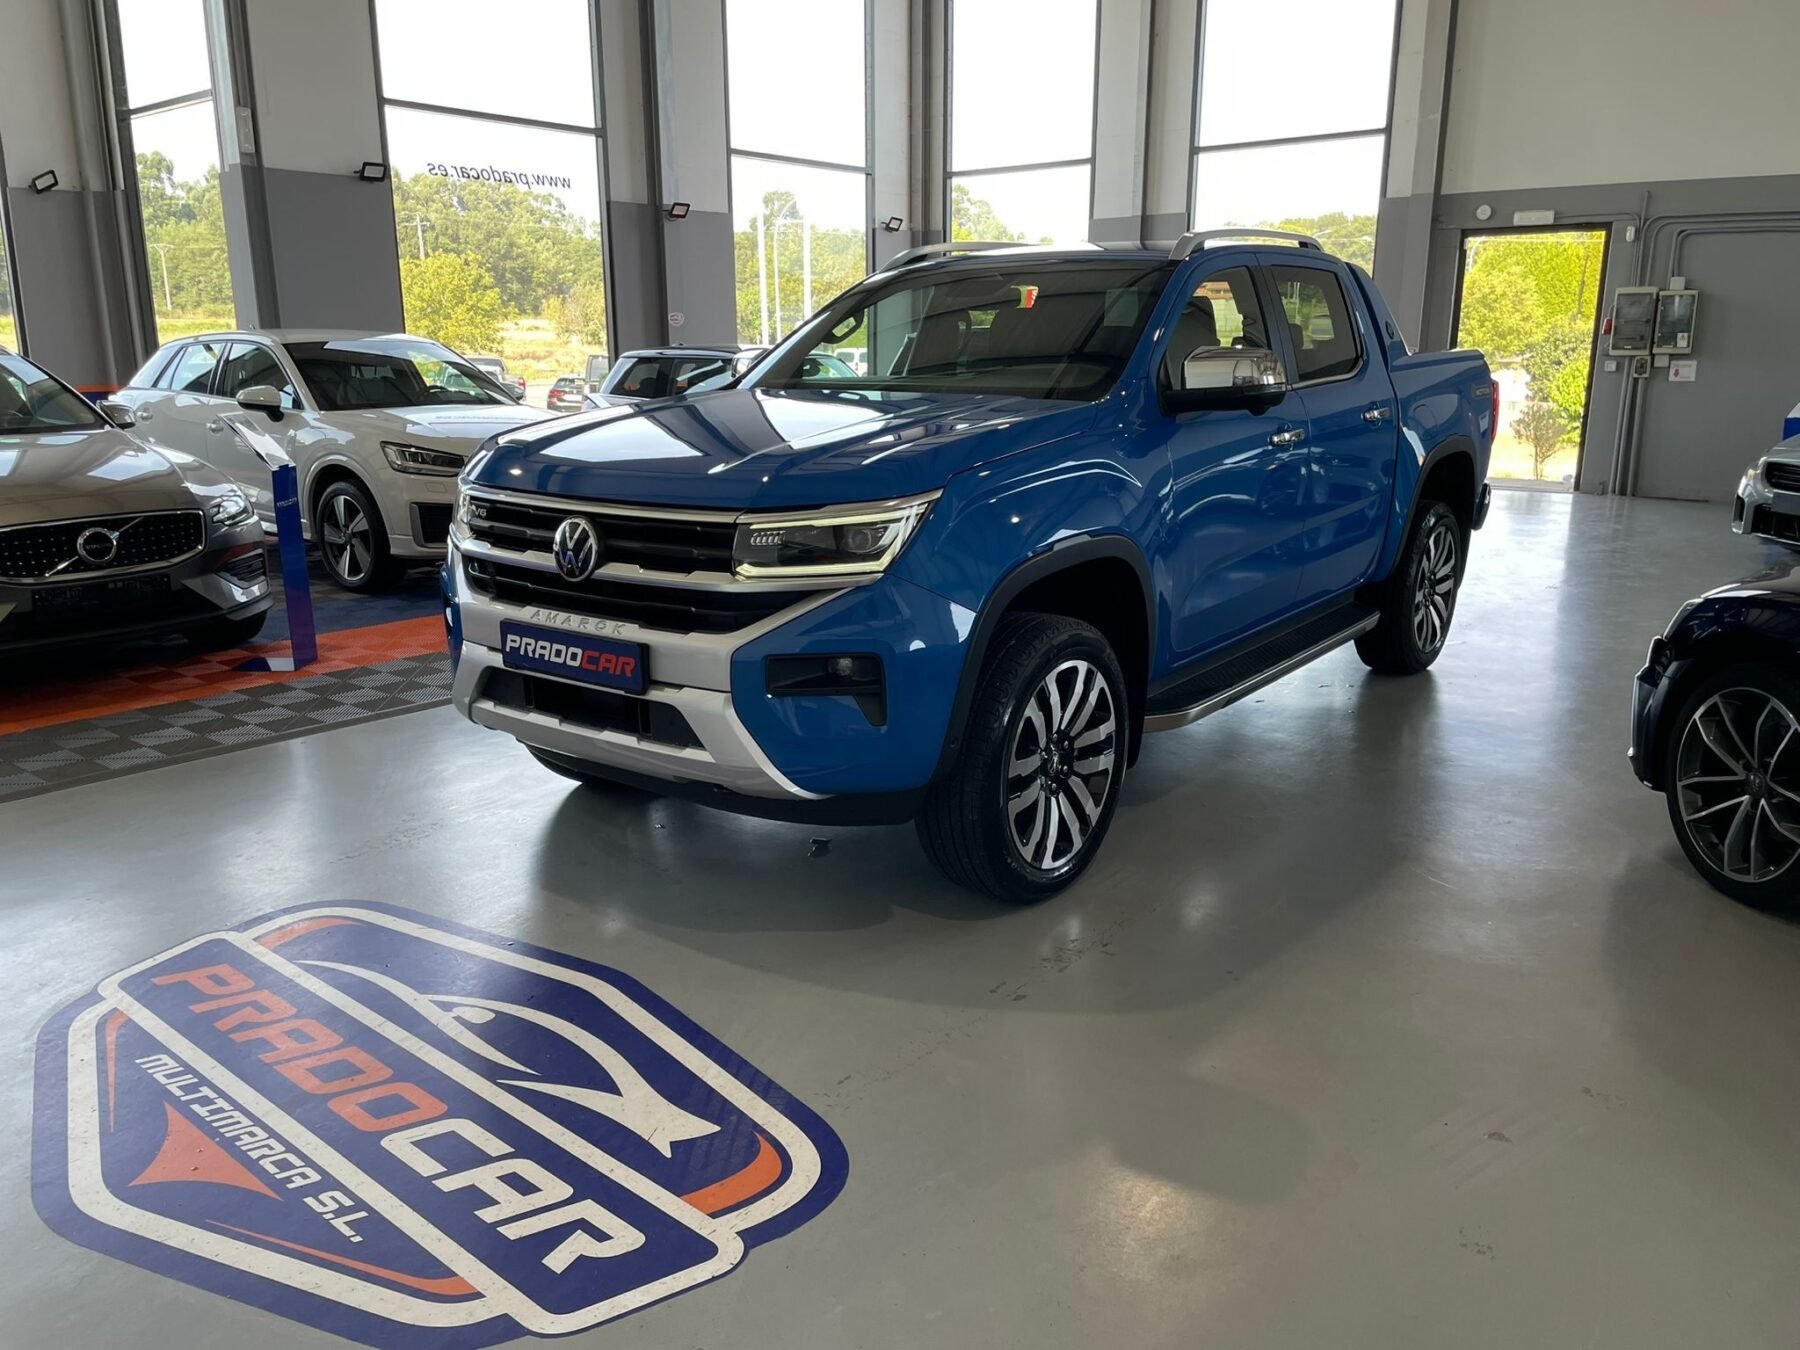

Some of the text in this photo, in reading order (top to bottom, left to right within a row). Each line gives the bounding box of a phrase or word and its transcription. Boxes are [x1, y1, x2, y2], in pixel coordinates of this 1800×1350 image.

[505, 633, 636, 677] PRADOCAR
[530, 610, 627, 635] AMAROK
[134, 1054, 369, 1243] MULTIMARCA S.L.
[150, 963, 646, 1275] PRADOCAR
